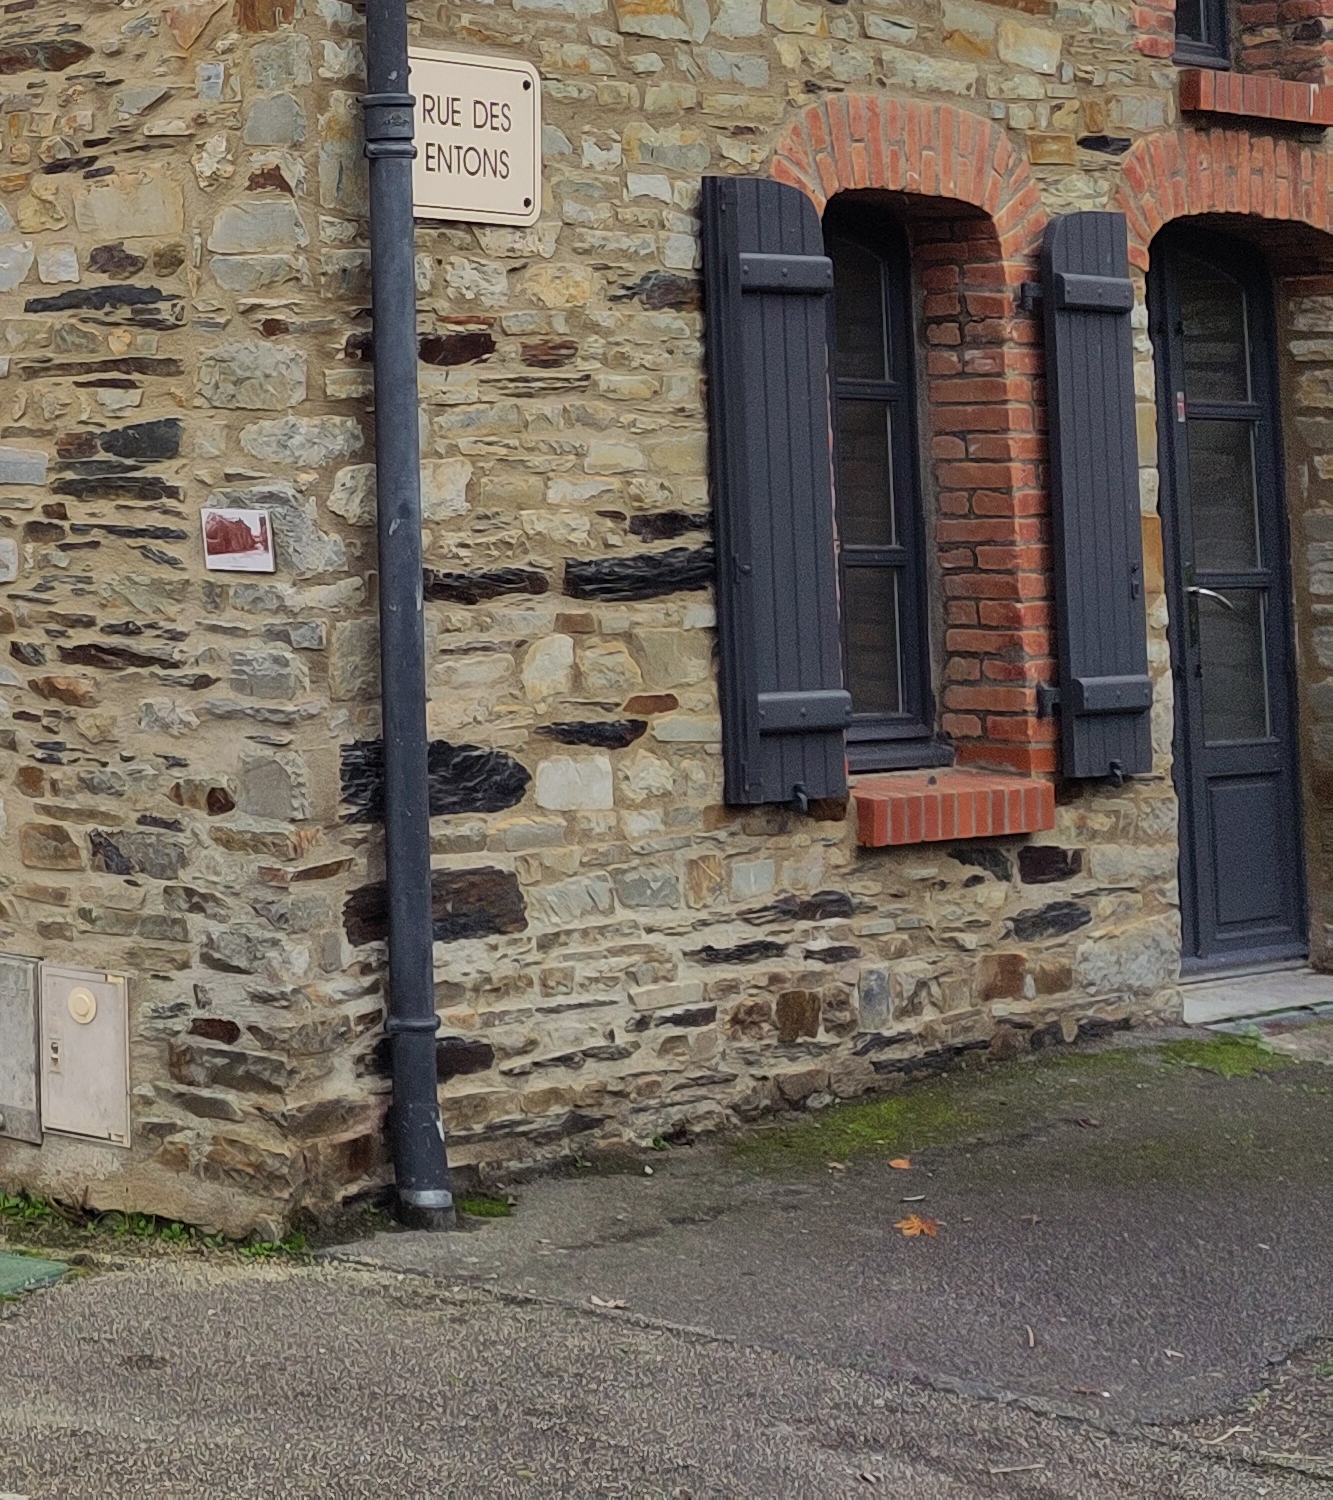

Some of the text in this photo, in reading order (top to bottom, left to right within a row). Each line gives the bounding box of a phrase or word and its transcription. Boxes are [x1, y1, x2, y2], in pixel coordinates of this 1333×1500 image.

[422, 94, 512, 133] RUE DES
[425, 142, 510, 180] ENTONS
